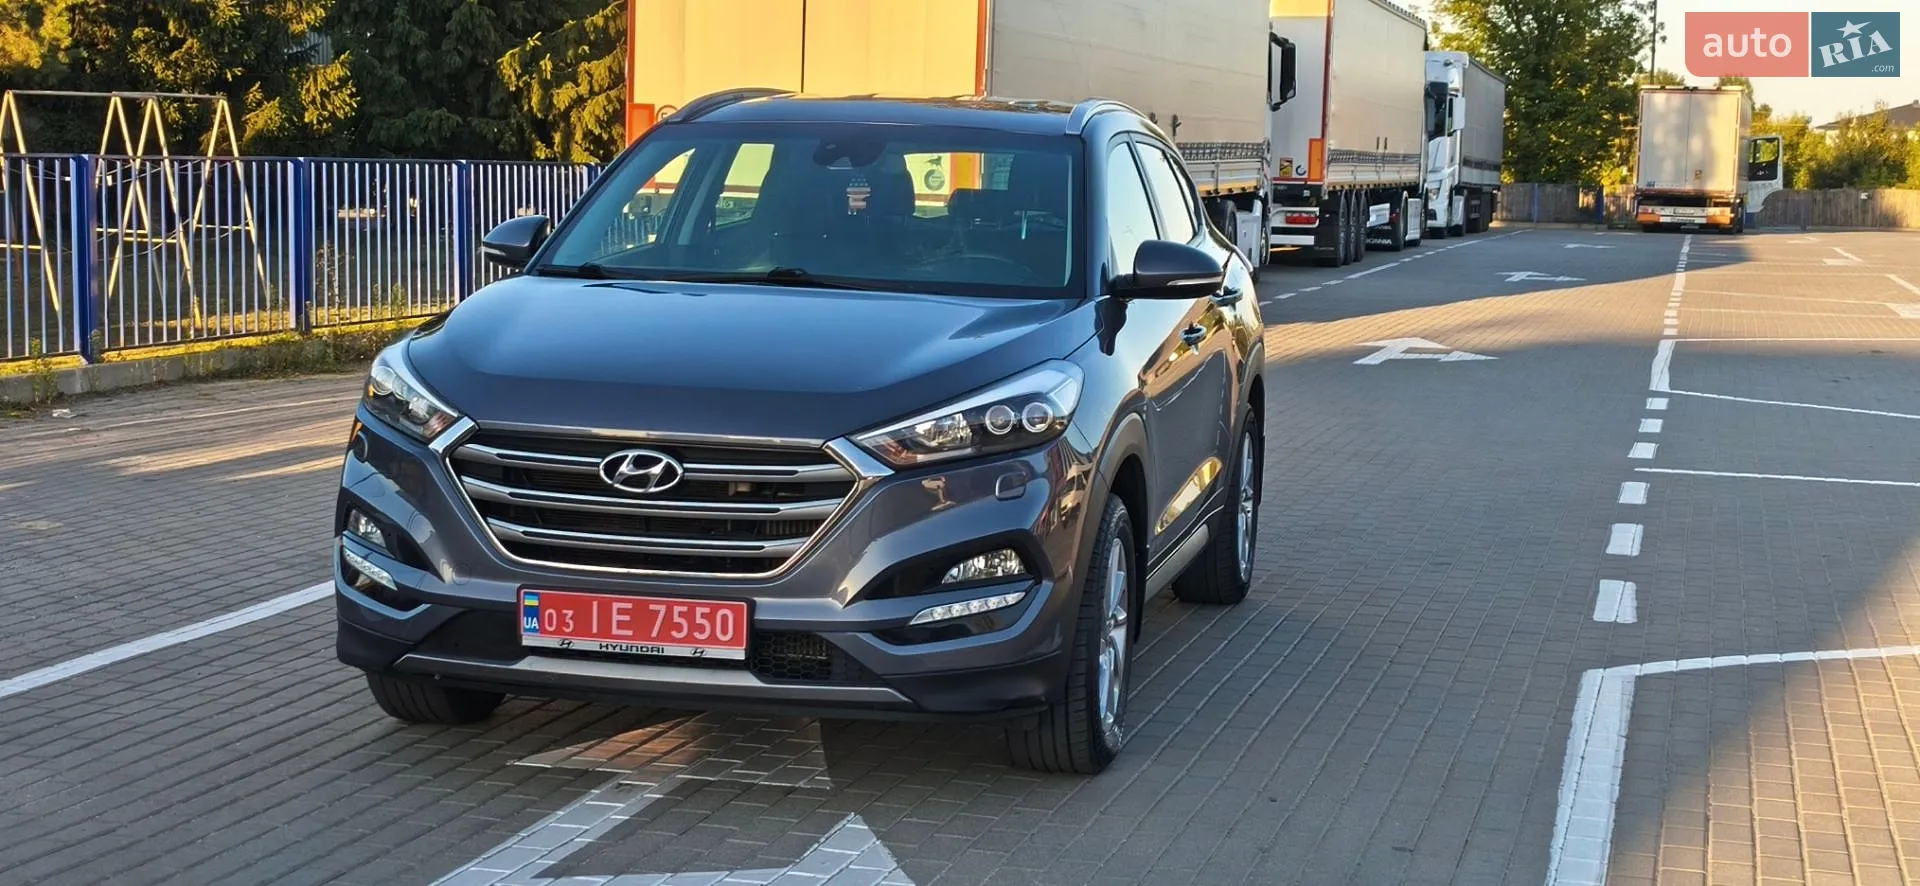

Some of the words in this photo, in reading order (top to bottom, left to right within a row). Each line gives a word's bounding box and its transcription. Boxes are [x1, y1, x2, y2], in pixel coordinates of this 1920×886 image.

[524, 616, 539, 629] UA
[544, 608, 574, 633] 03
[592, 601, 633, 636] IE
[649, 604, 734, 642] 7550
[599, 643, 665, 654] HYUNDAI
